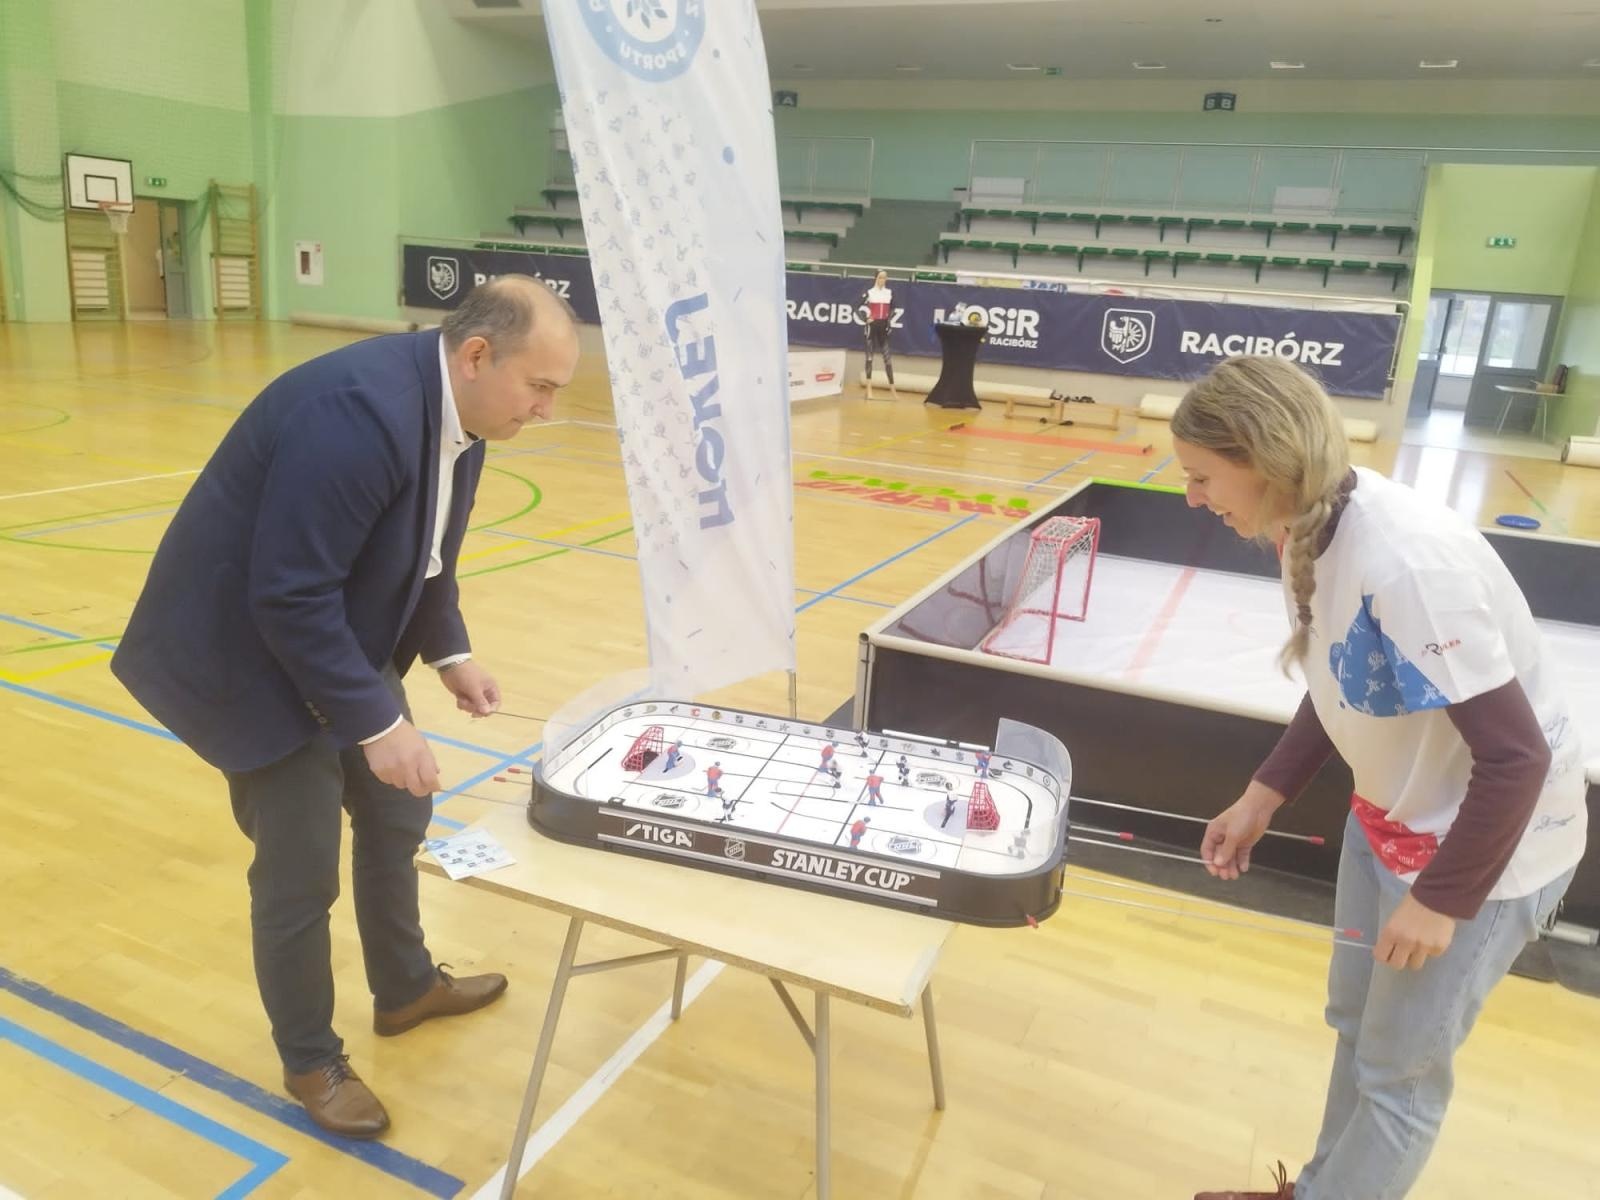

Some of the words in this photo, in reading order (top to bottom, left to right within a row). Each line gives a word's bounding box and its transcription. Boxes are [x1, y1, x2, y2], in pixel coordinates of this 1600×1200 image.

[989, 336, 1038, 349] RACIBÓRZ
[1180, 331, 1345, 367] RACIBÓRZ
[626, 823, 693, 848] STIGA
[771, 849, 864, 884] STANLEY
[864, 867, 911, 891] CUP
